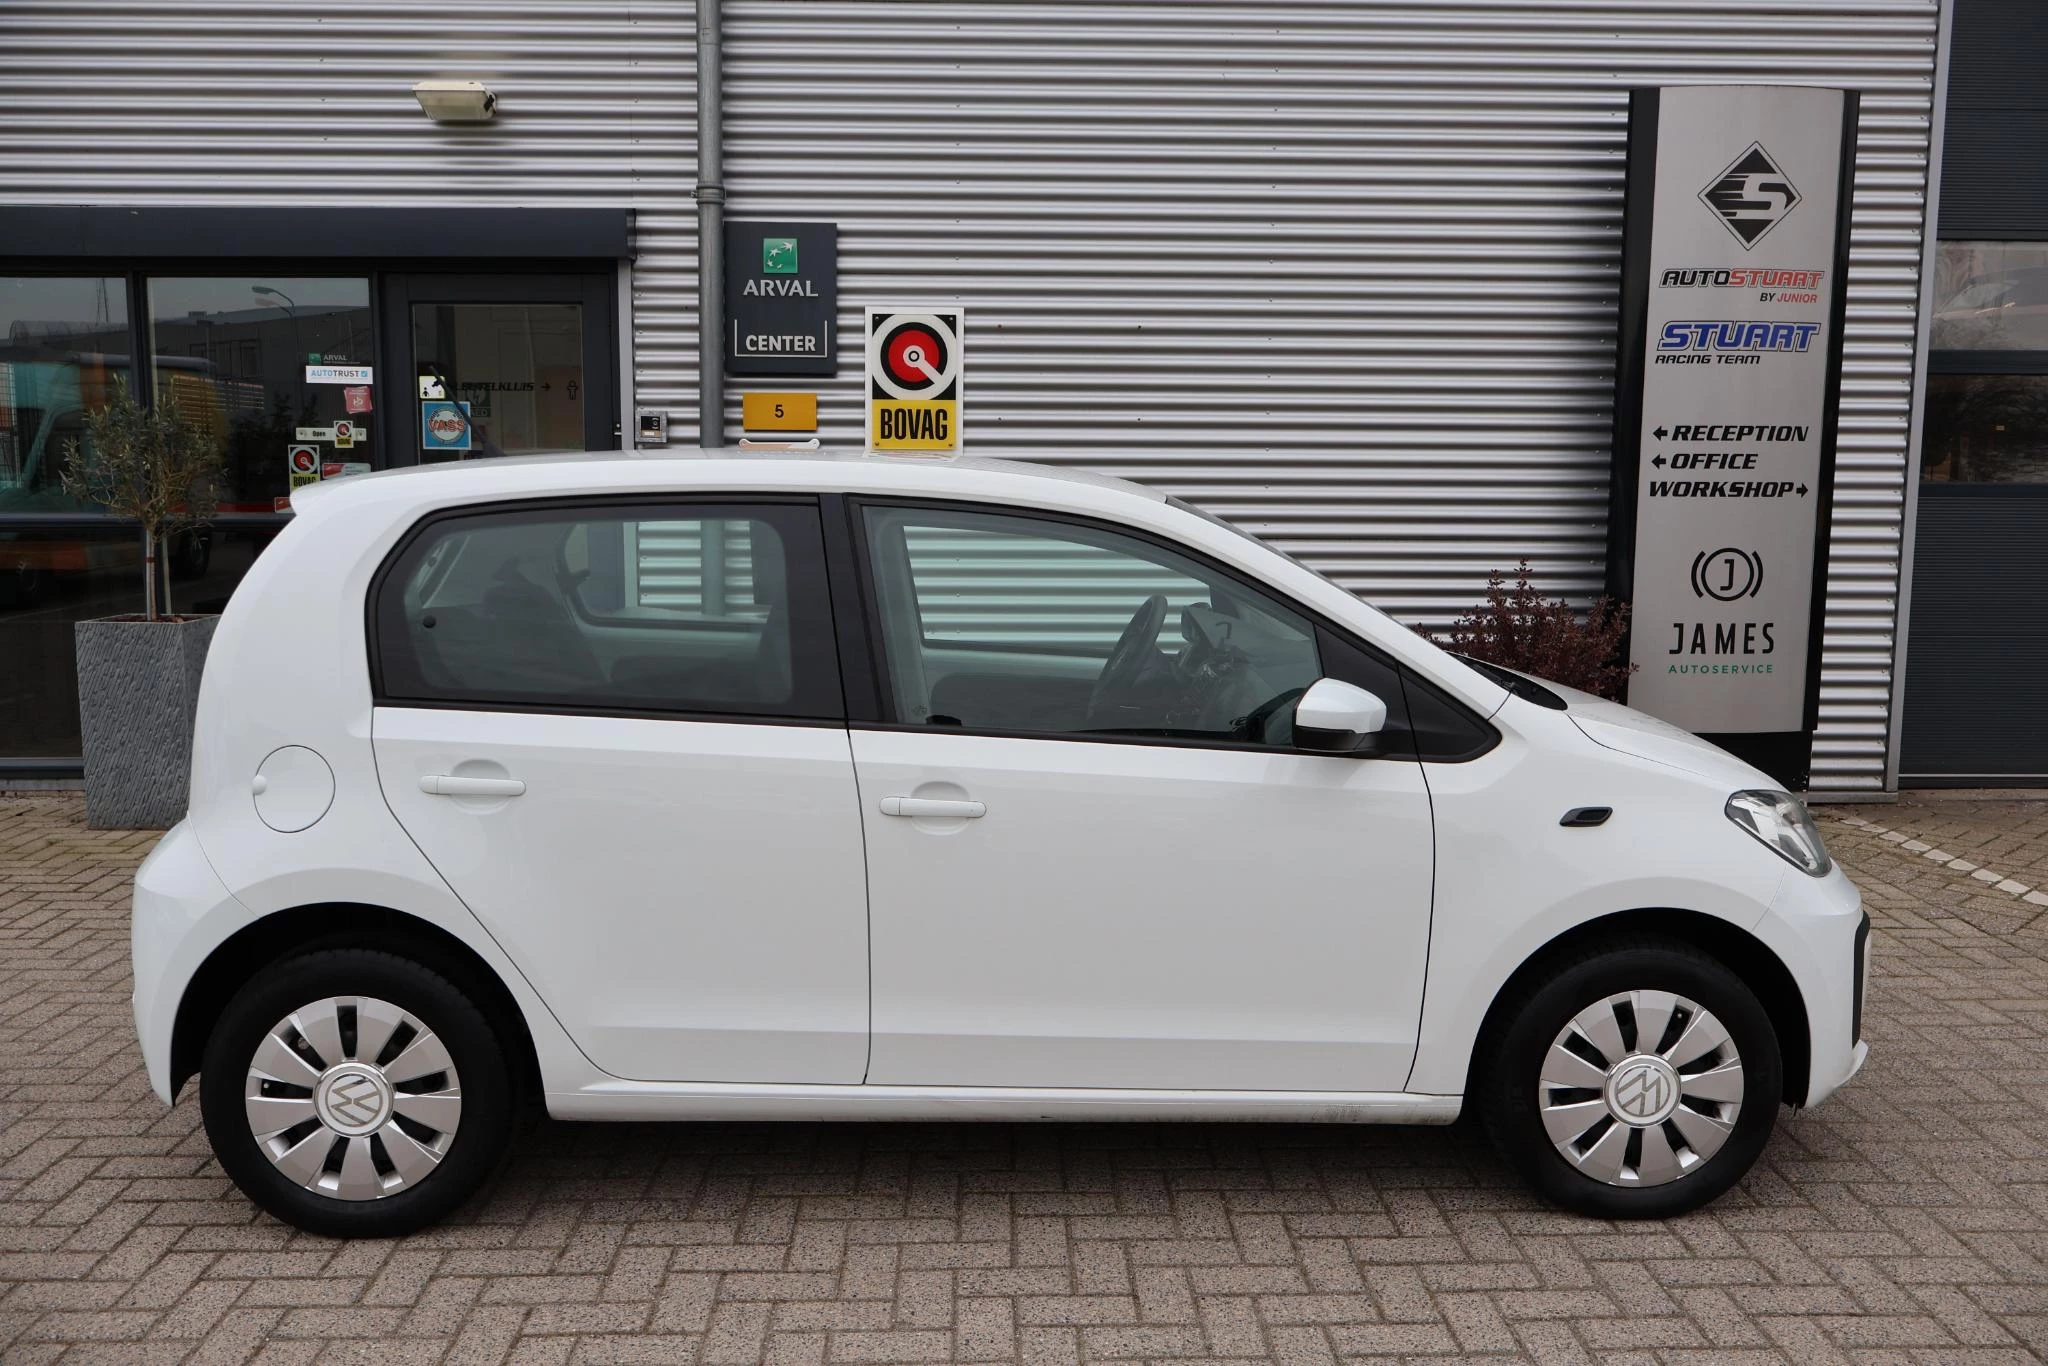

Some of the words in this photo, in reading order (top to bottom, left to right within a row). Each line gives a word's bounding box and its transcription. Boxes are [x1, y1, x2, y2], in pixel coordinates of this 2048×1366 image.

[743, 279, 819, 297] ARVAL
[1760, 292, 1776, 302] BY
[1777, 293, 1818, 303] JUNIOR
[745, 335, 816, 351] CENTER
[1657, 321, 1821, 352] STUART
[1655, 354, 1712, 365] RACING
[1716, 355, 1761, 365] TEAM
[311, 369, 360, 378] AUTOTRUST
[774, 404, 785, 418] 5
[880, 408, 948, 440] BOVAG
[1671, 425, 1809, 442] RECEPTION
[1670, 453, 1759, 469] OFFICE
[1649, 481, 1794, 498] WORKSHOP
[1668, 622, 1774, 655] JAMES
[1668, 664, 1773, 675] AUTOSERVICE
